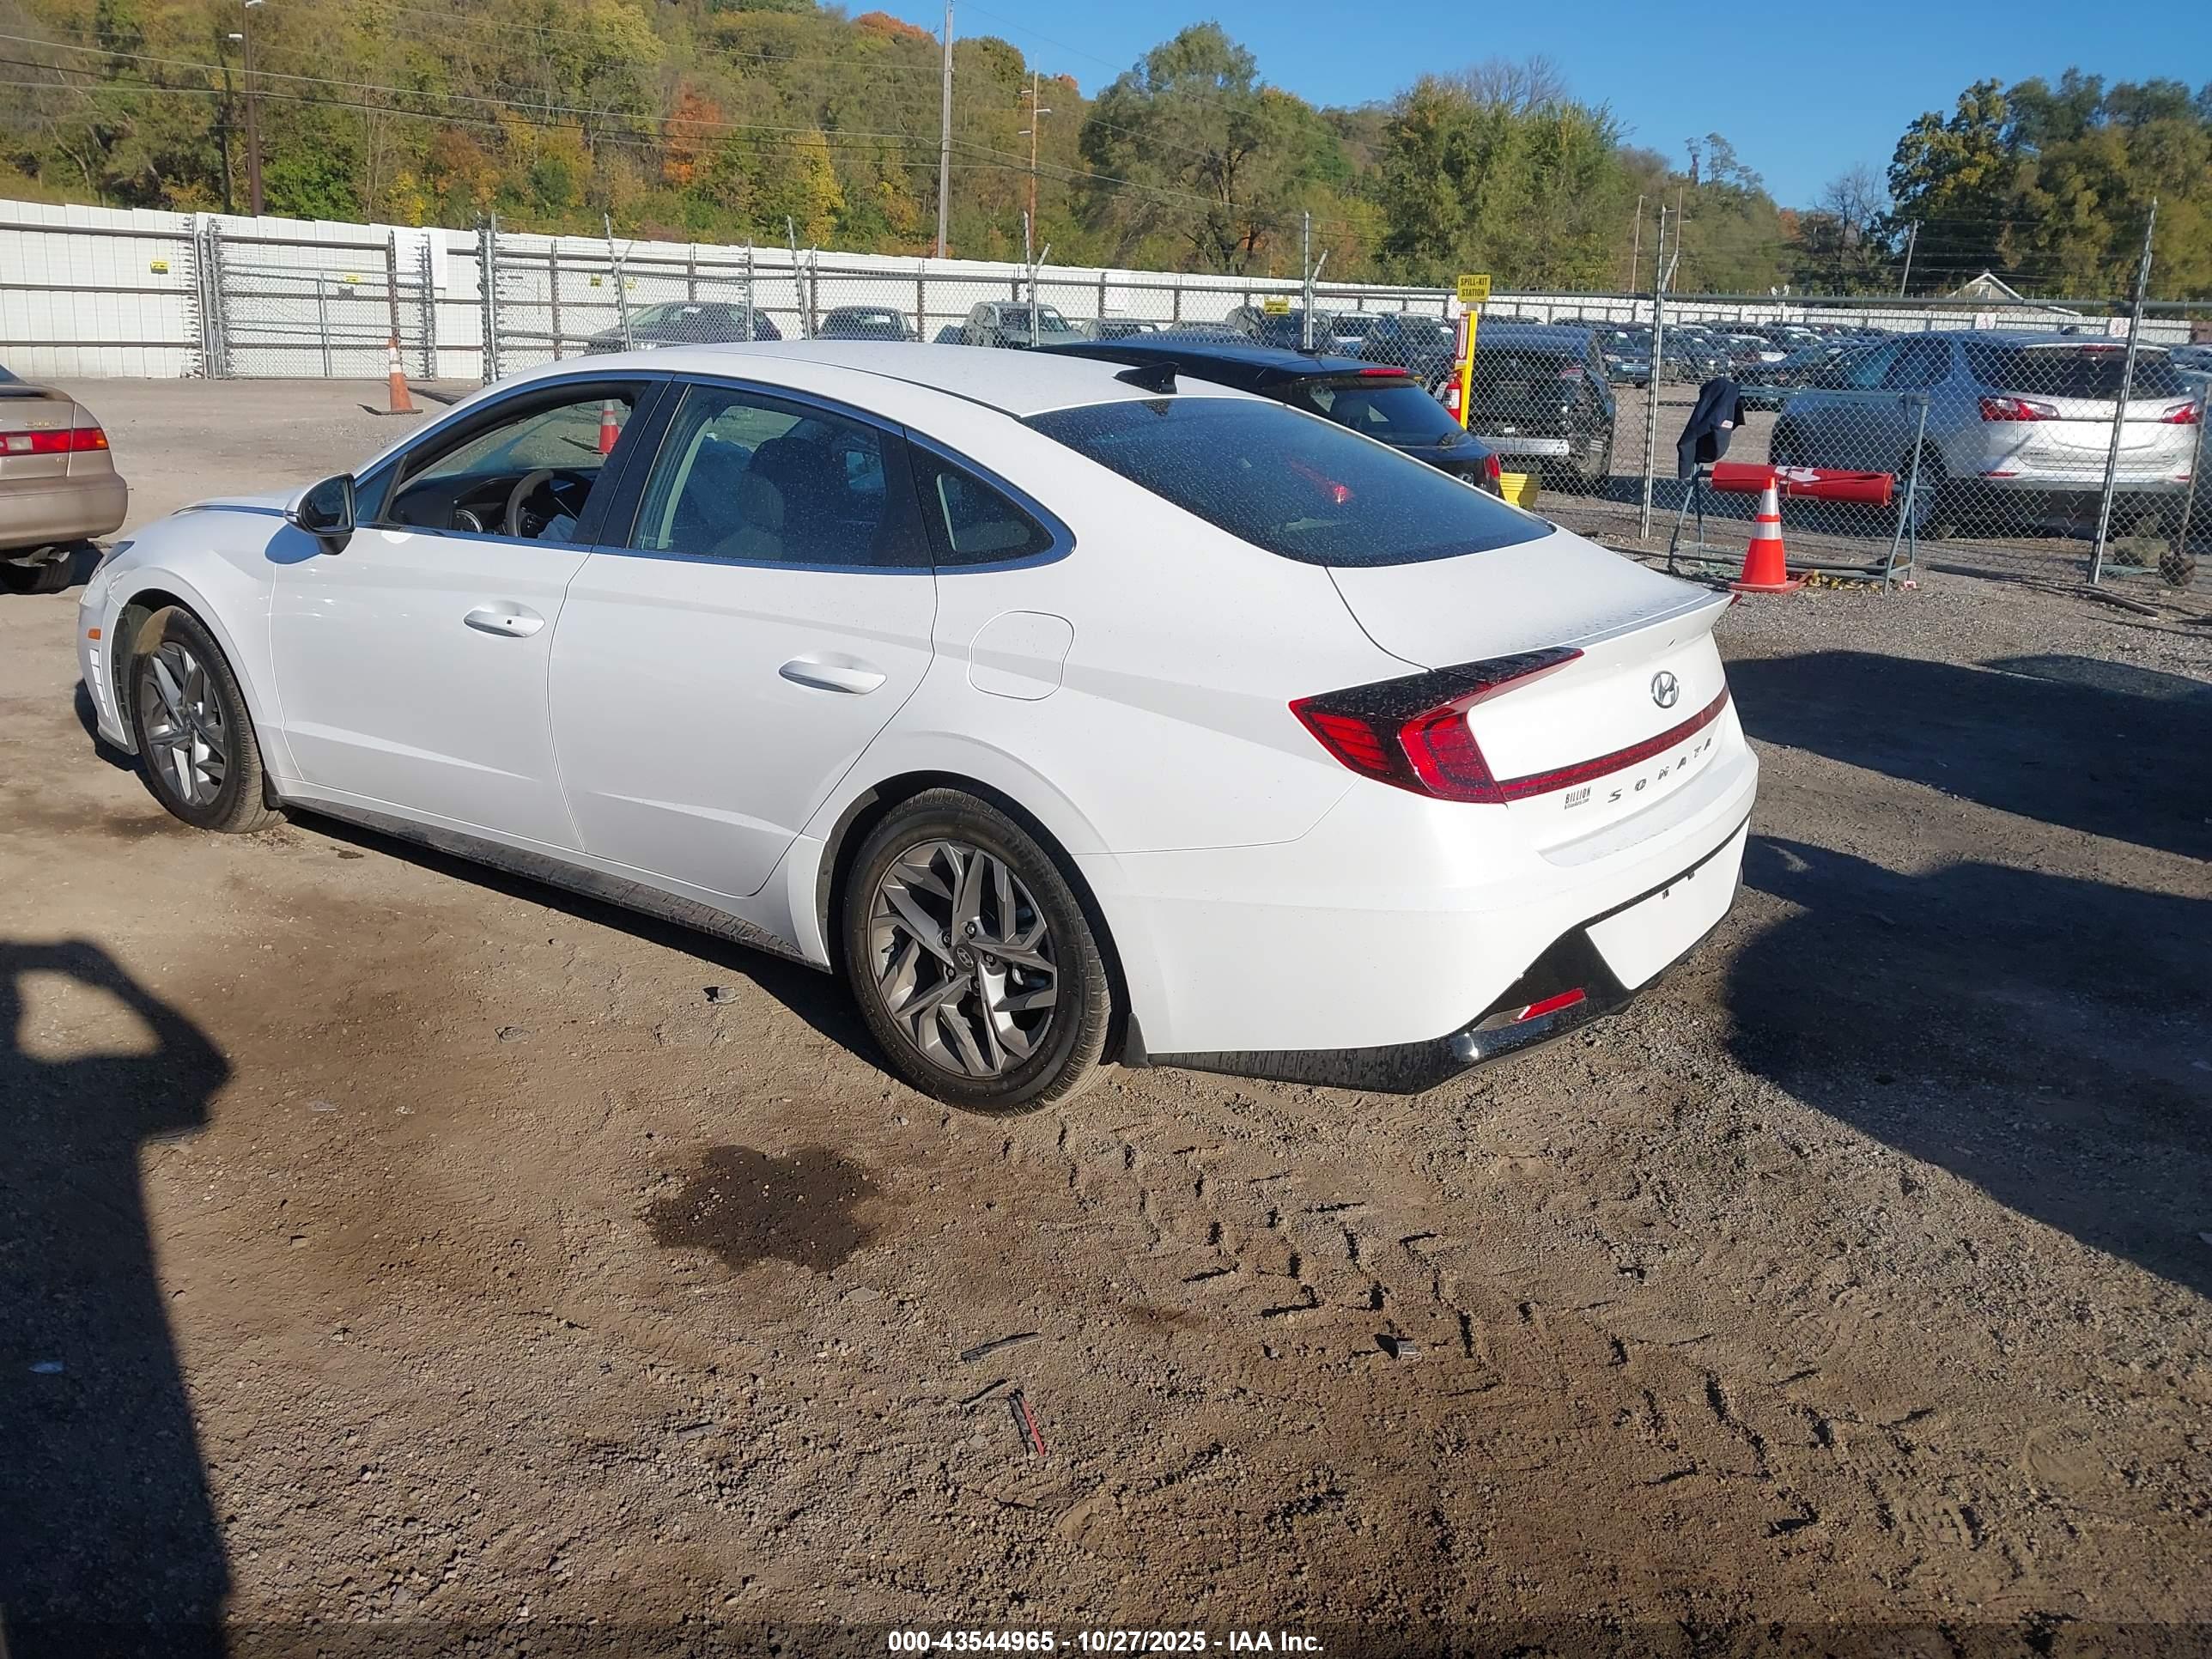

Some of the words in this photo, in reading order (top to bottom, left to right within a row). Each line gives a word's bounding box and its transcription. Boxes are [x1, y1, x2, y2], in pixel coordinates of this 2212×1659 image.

[1460, 276, 1487, 286] SPILL-KIT
[1462, 288, 1486, 297] STATION
[1607, 737, 1711, 804] SONATA
[1565, 786, 1591, 805] BILLION
